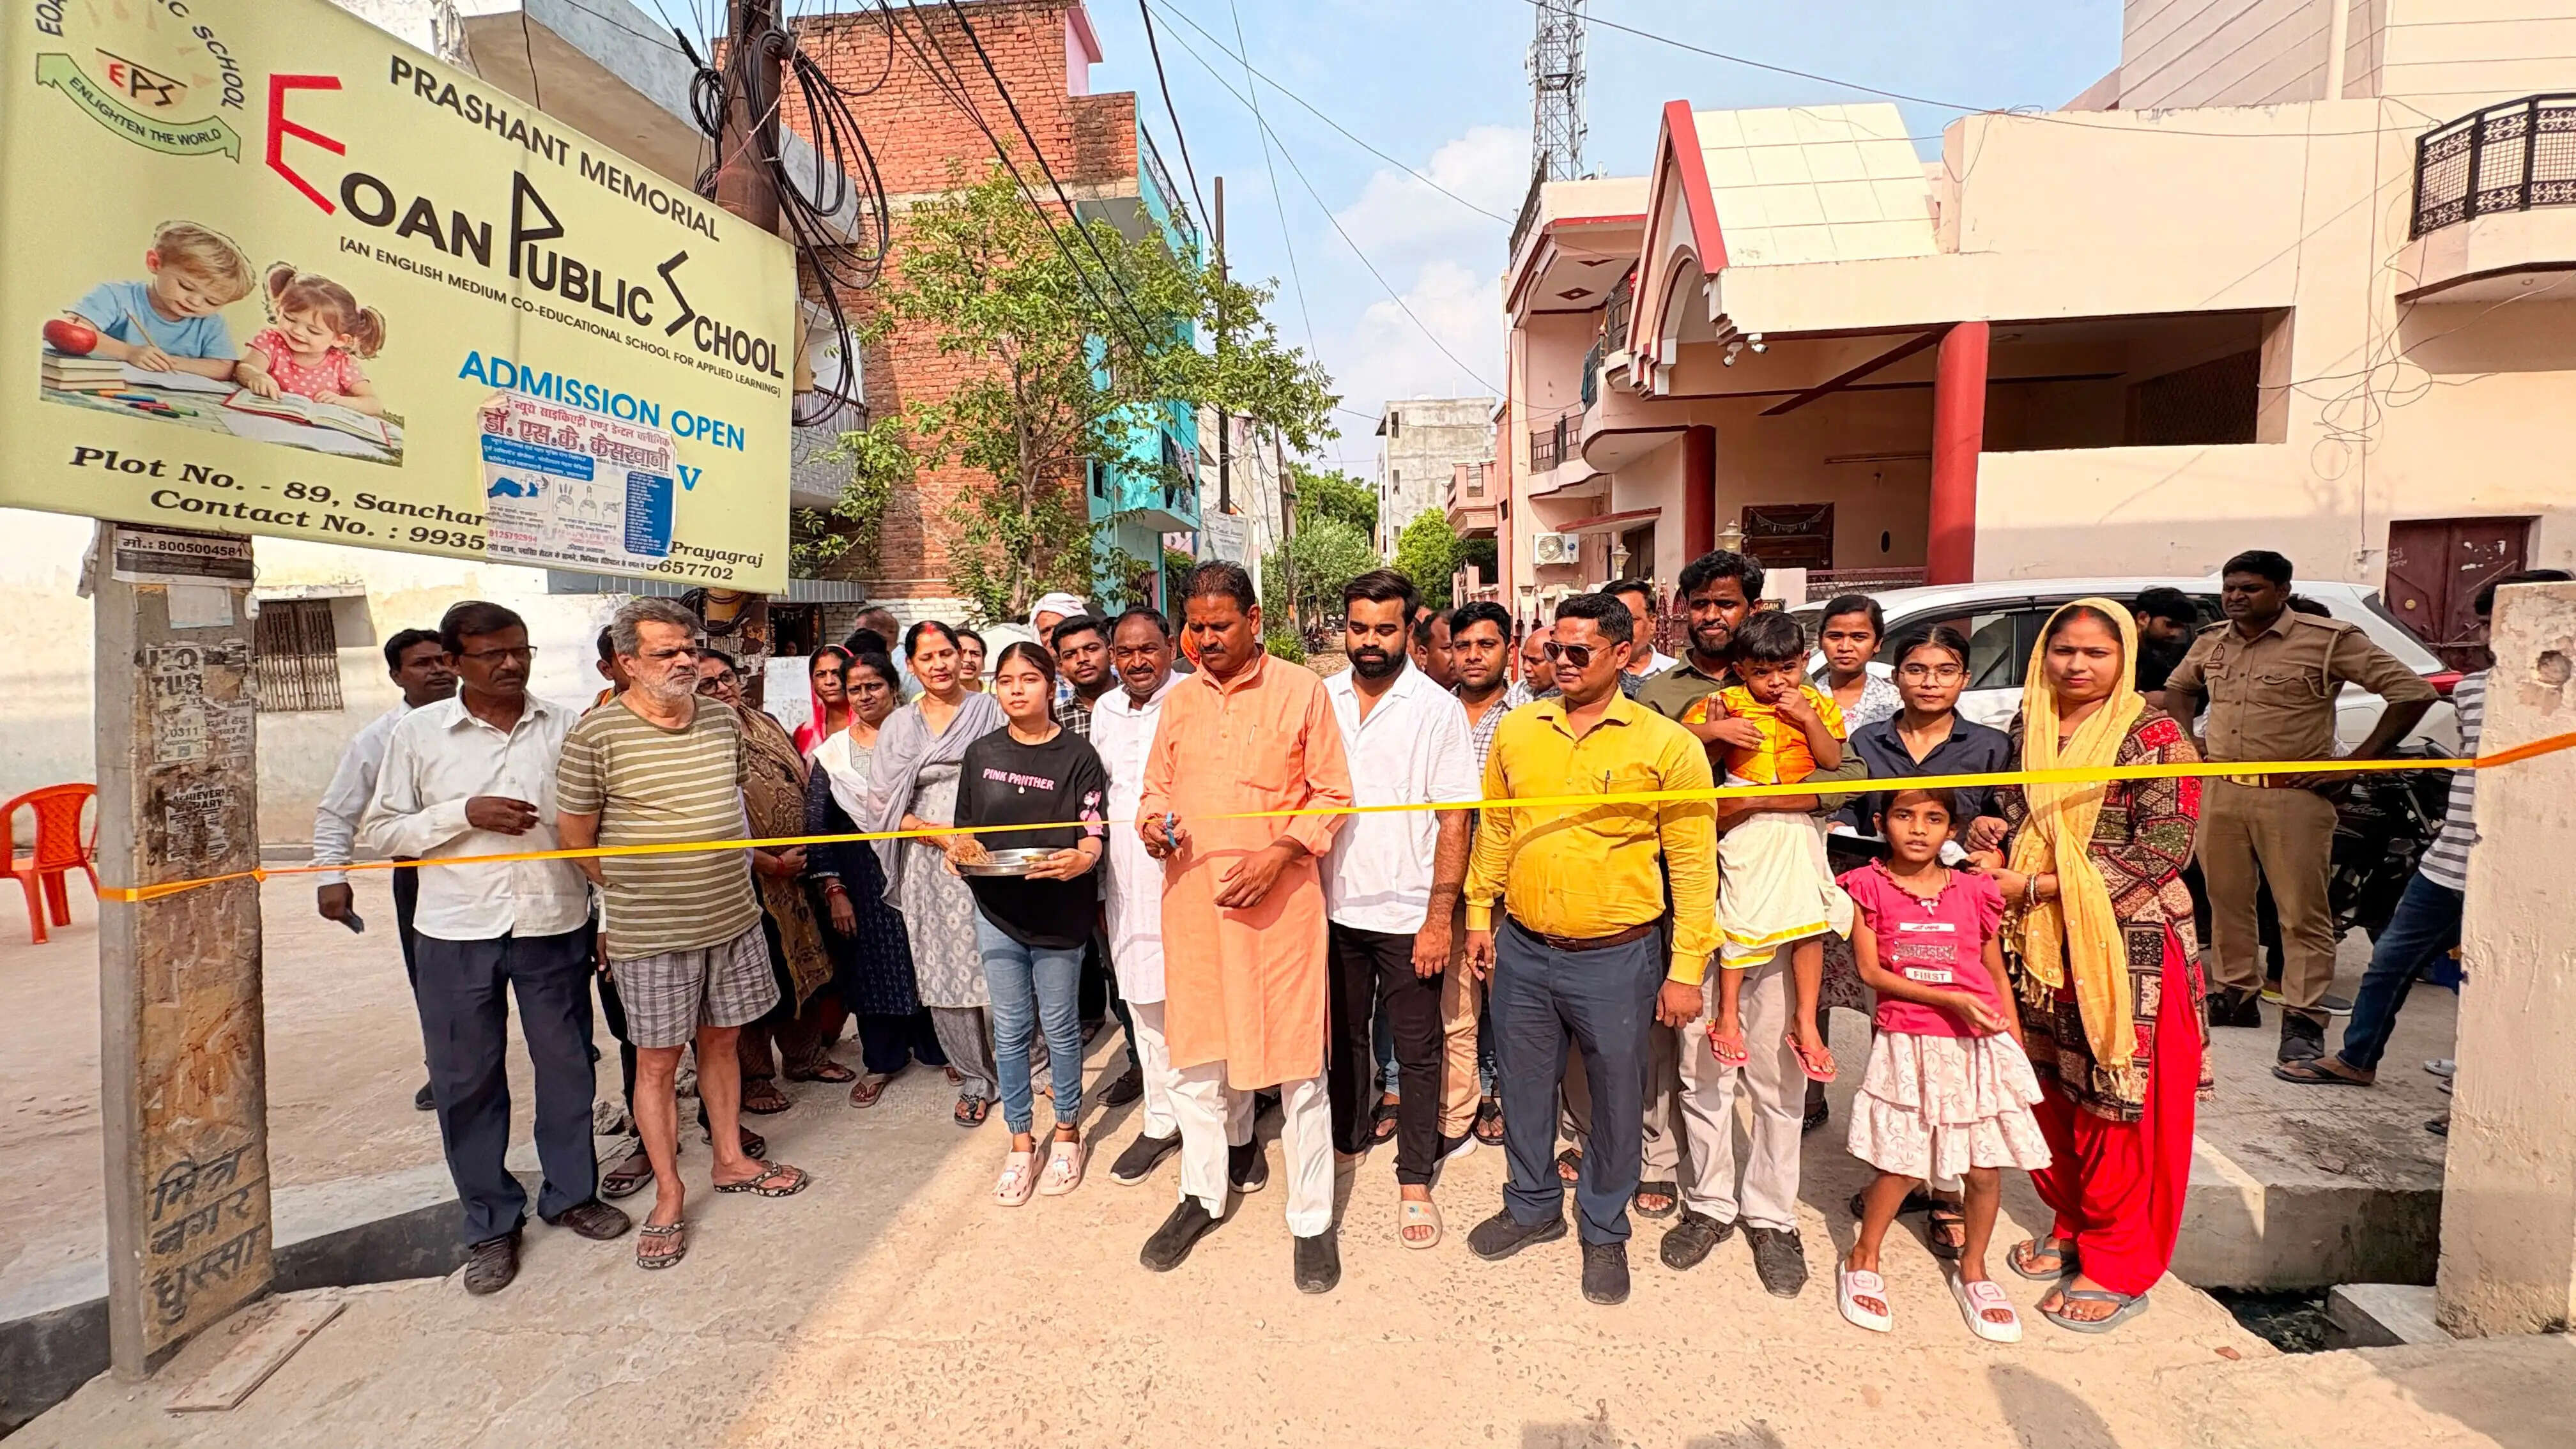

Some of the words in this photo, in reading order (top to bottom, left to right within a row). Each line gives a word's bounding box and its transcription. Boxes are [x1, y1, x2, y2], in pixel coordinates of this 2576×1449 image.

[192, 25, 245, 111] SCHOOL
[69, 76, 146, 137] ENLIGHTEN
[149, 128, 177, 145] THE
[177, 128, 222, 146] WORLD
[390, 54, 571, 167] PRASHANT
[579, 151, 720, 243] MEMORIAL
[266, 73, 492, 268] EOAN
[509, 171, 654, 326] PUBLIC
[657, 250, 785, 379] SCHOOL
[376, 248, 443, 282] ENGLISH
[447, 273, 507, 305] MEDIUM
[510, 296, 623, 344] CO-EDUCATIONAL
[625, 335, 671, 360] SCHOOL
[673, 351, 694, 368] FOR
[696, 360, 733, 381] APPLIED
[458, 350, 660, 427] ADMISSION
[671, 410, 745, 452] OPEN
[68, 446, 167, 477] Plot
[178, 463, 245, 491] No.
[283, 482, 341, 507] 89,
[353, 492, 486, 526] Sanchar
[150, 489, 310, 528] Contact
[319, 514, 374, 537] No.
[158, 540, 243, 557] 8005004581
[670, 540, 764, 569] Prayagraj
[983, 768, 1008, 782] PINK
[1008, 772, 1055, 790] PANTHER
[1913, 970, 1947, 981] FIRST
